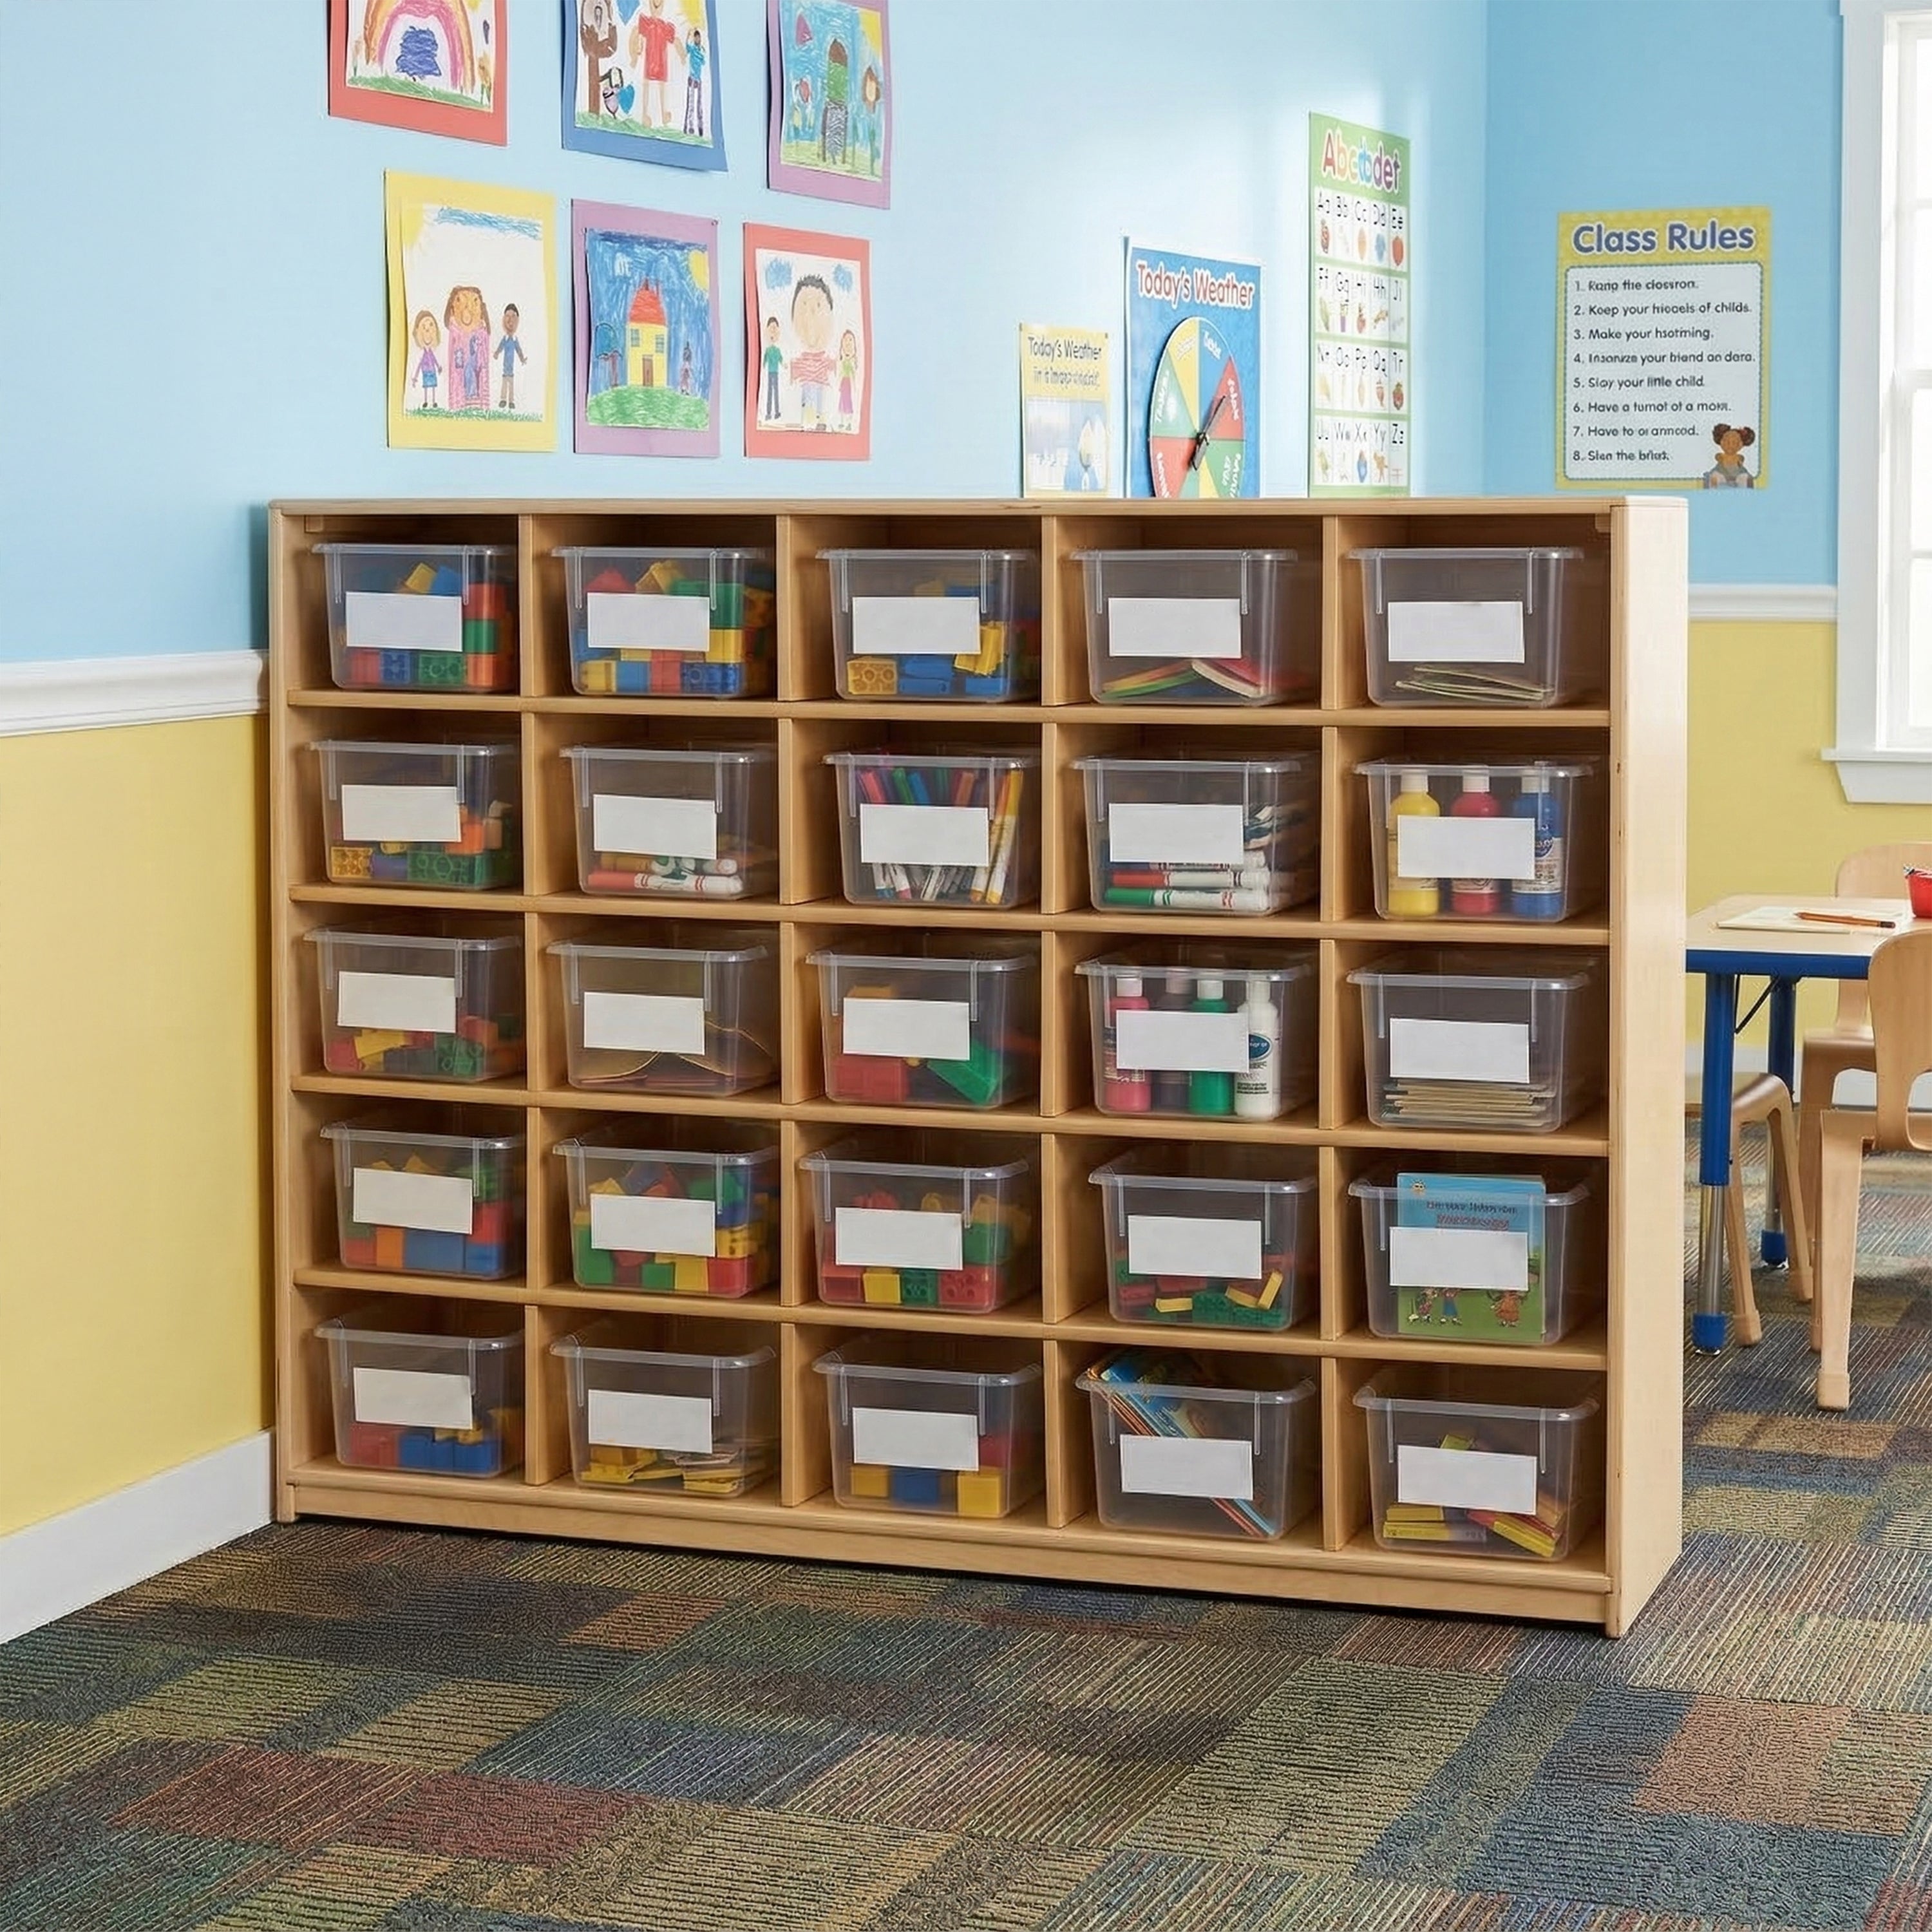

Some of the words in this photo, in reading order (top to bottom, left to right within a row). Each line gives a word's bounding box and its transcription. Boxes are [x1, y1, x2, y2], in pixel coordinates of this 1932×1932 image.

[1572, 223, 1656, 252] Class
[1667, 220, 1755, 251] Rules
[1137, 263, 1190, 306] Today's
[1195, 270, 1253, 307] Weather
[1574, 305, 1585, 316] 2.
[1622, 306, 1649, 316] your
[1573, 328, 1585, 340] 3.
[1625, 330, 1652, 342] your
[1028, 335, 1063, 363] Today's
[1640, 354, 1667, 366] your
[1573, 377, 1585, 388] 5.
[1617, 378, 1644, 390] your
[1573, 402, 1584, 413] 6.
[1622, 404, 1630, 412] a
[1685, 403, 1694, 412] a
[1573, 426, 1584, 437] 7.
[1622, 425, 1634, 437] to
[1573, 450, 1585, 461] 8.
